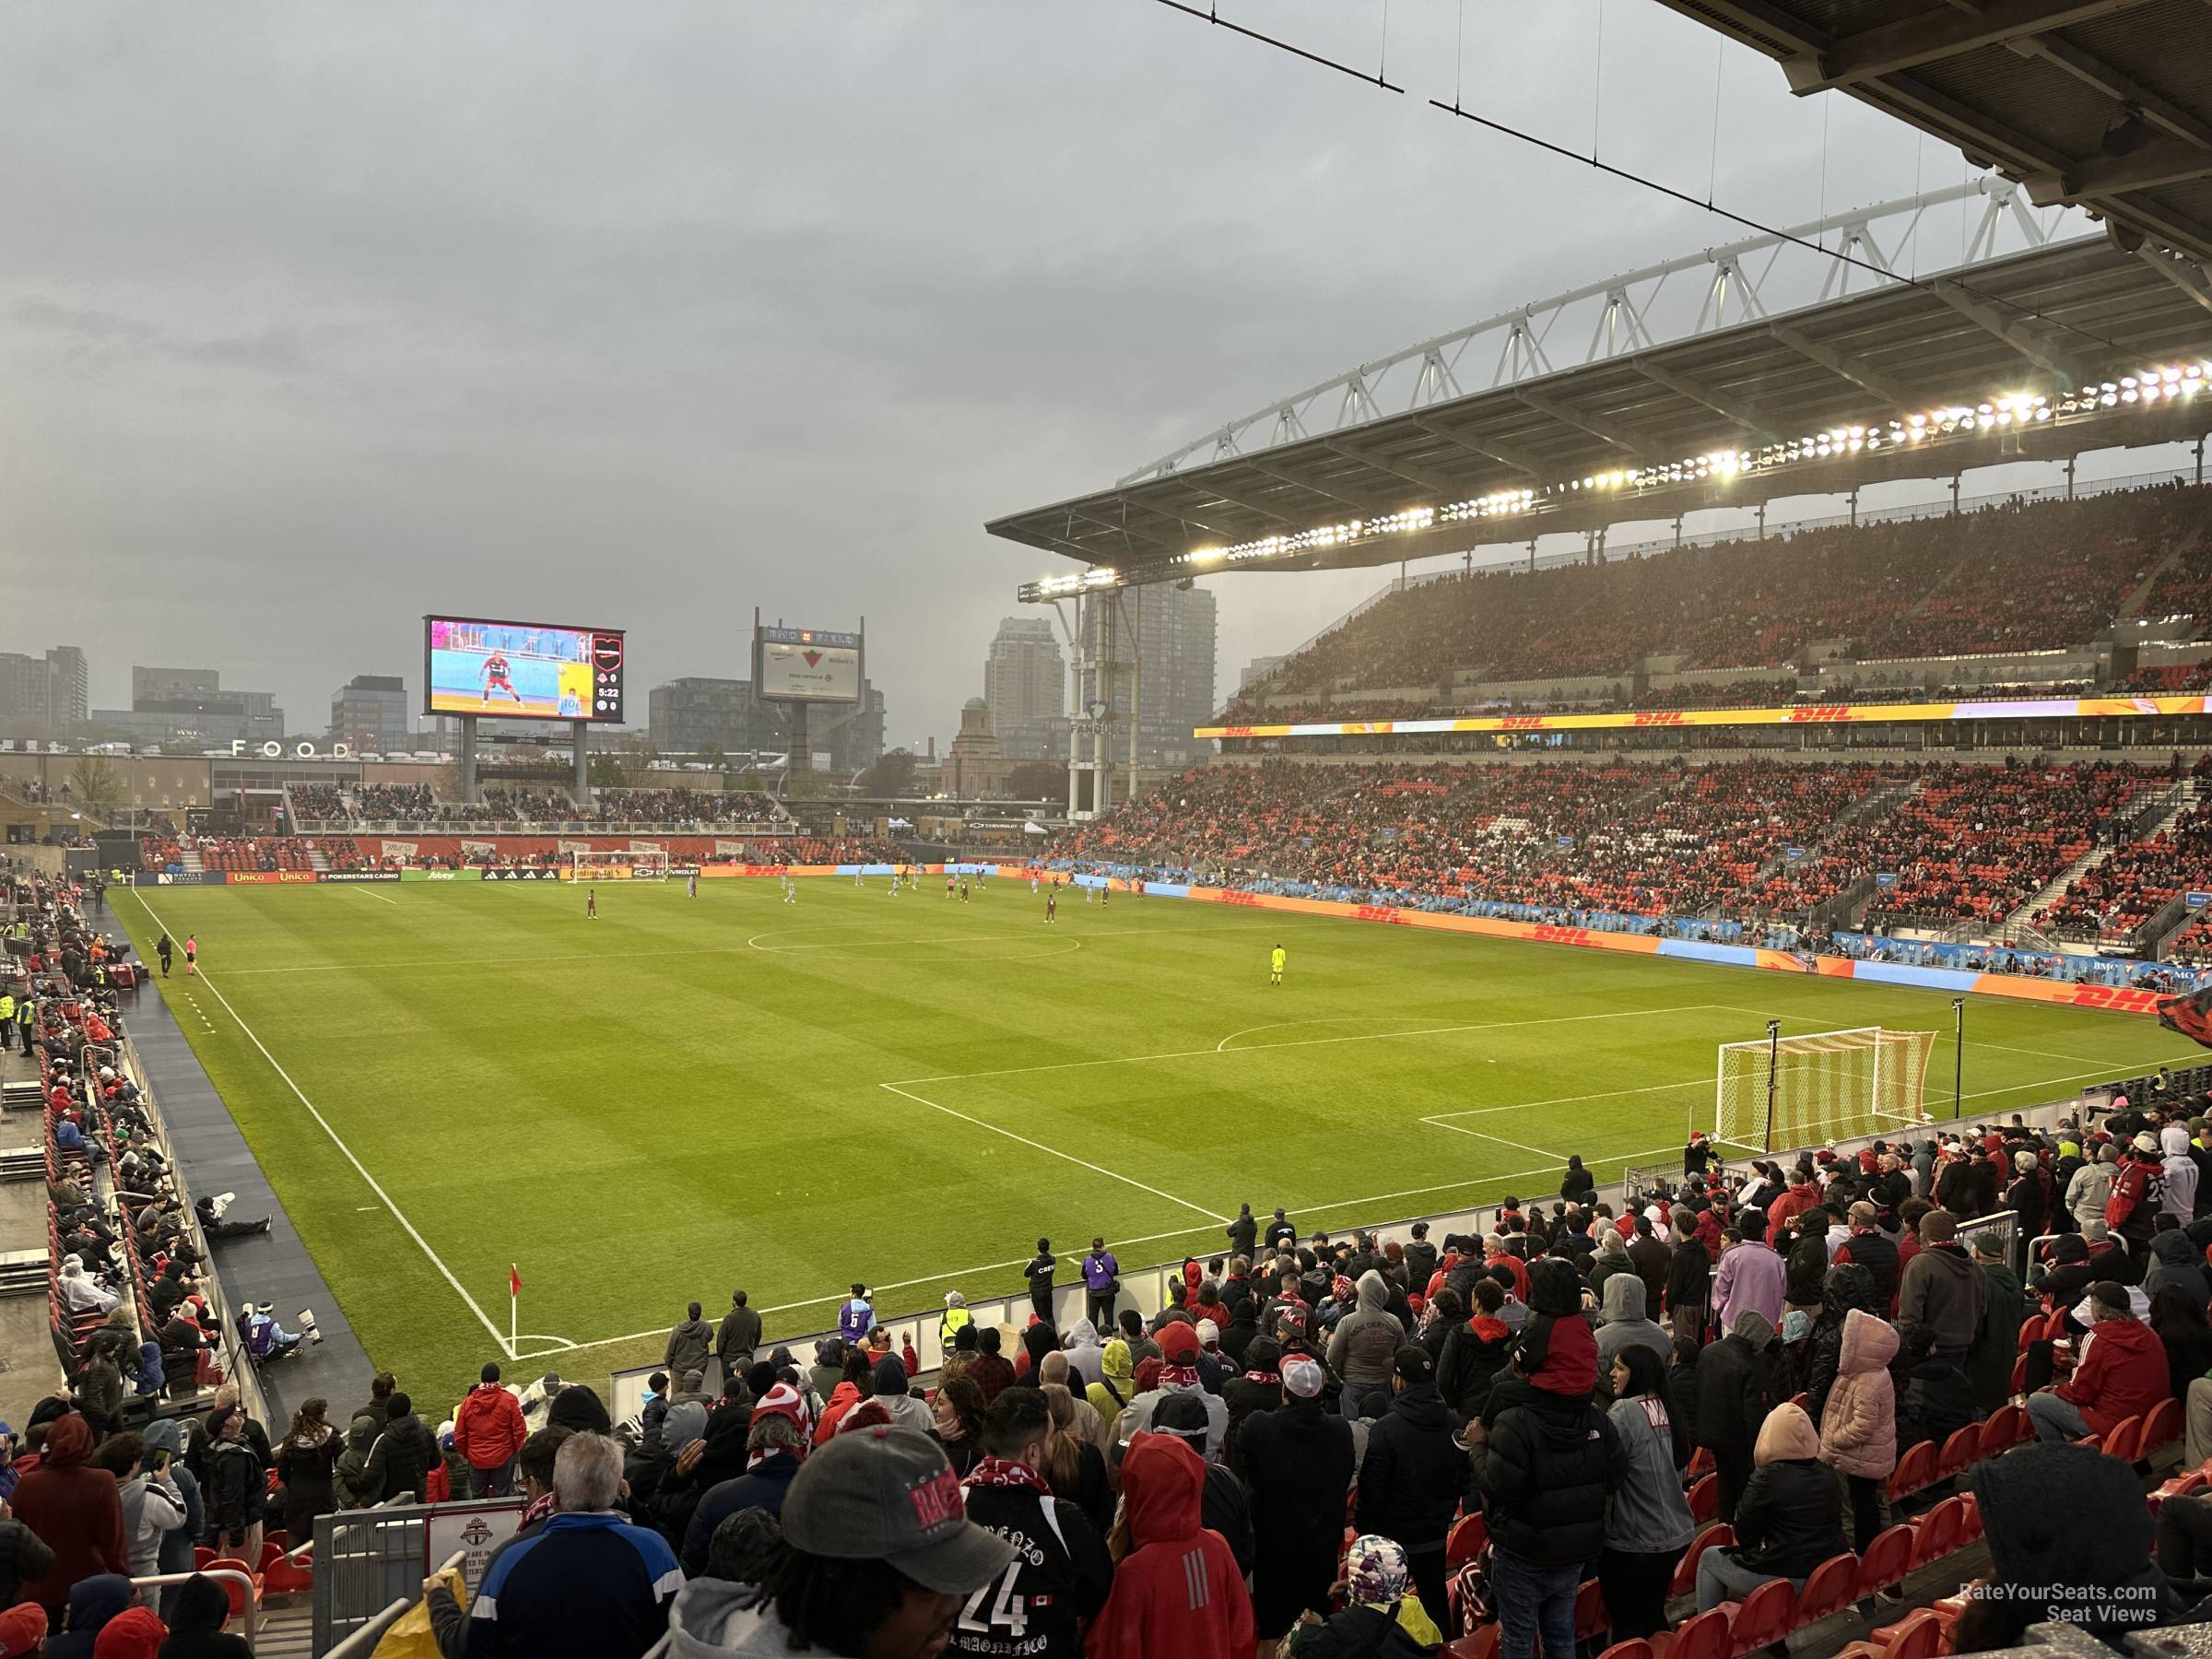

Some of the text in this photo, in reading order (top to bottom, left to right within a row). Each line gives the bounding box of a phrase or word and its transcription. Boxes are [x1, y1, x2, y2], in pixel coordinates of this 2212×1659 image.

[610, 673, 617, 683] 0
[598, 688, 619, 698] 5:22
[610, 701, 617, 711] 0
[1634, 712, 1685, 725] DHL
[1791, 707, 1853, 722] DHL
[1501, 716, 1546, 729] DHL
[231, 739, 348, 759] FOOD
[233, 873, 265, 882] Unico
[279, 872, 310, 882] Unico
[1220, 889, 1257, 907] DHL
[1534, 924, 1592, 946] DHL
[2174, 971, 2194, 980] MO
